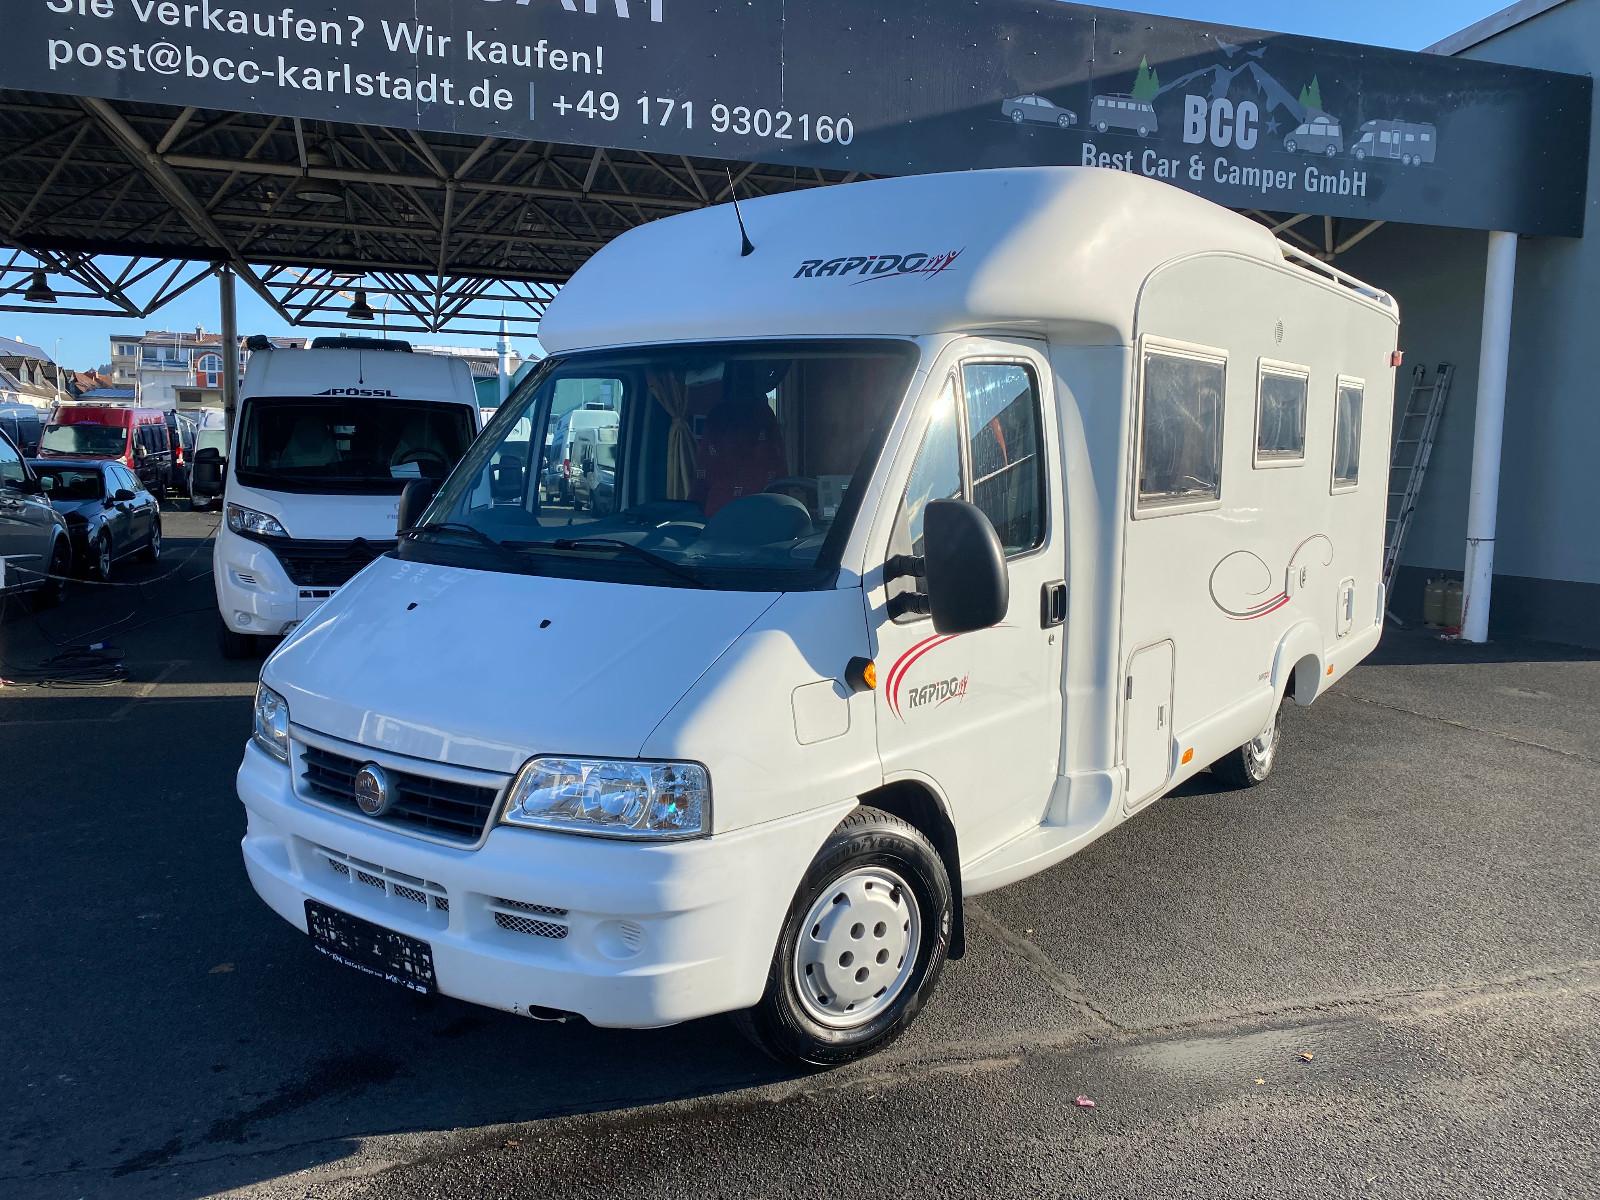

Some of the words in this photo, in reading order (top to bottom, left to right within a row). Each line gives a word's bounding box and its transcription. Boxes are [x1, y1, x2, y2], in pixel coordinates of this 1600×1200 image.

[130, 0, 365, 47] verkaufen?
[381, 20, 452, 58] Wir
[466, 30, 604, 75] kaufen!
[48, 39, 514, 111] post@bcc-karlstadt.de
[552, 90, 620, 122] +49
[637, 96, 693, 129] 171
[710, 103, 854, 146] 9302160
[1182, 94, 1260, 151] BCC
[1081, 142, 1134, 174] Best
[1141, 149, 1181, 179] Car
[1188, 154, 1206, 182] &
[1213, 157, 1298, 195] Camper
[1304, 167, 1367, 198] GmbH
